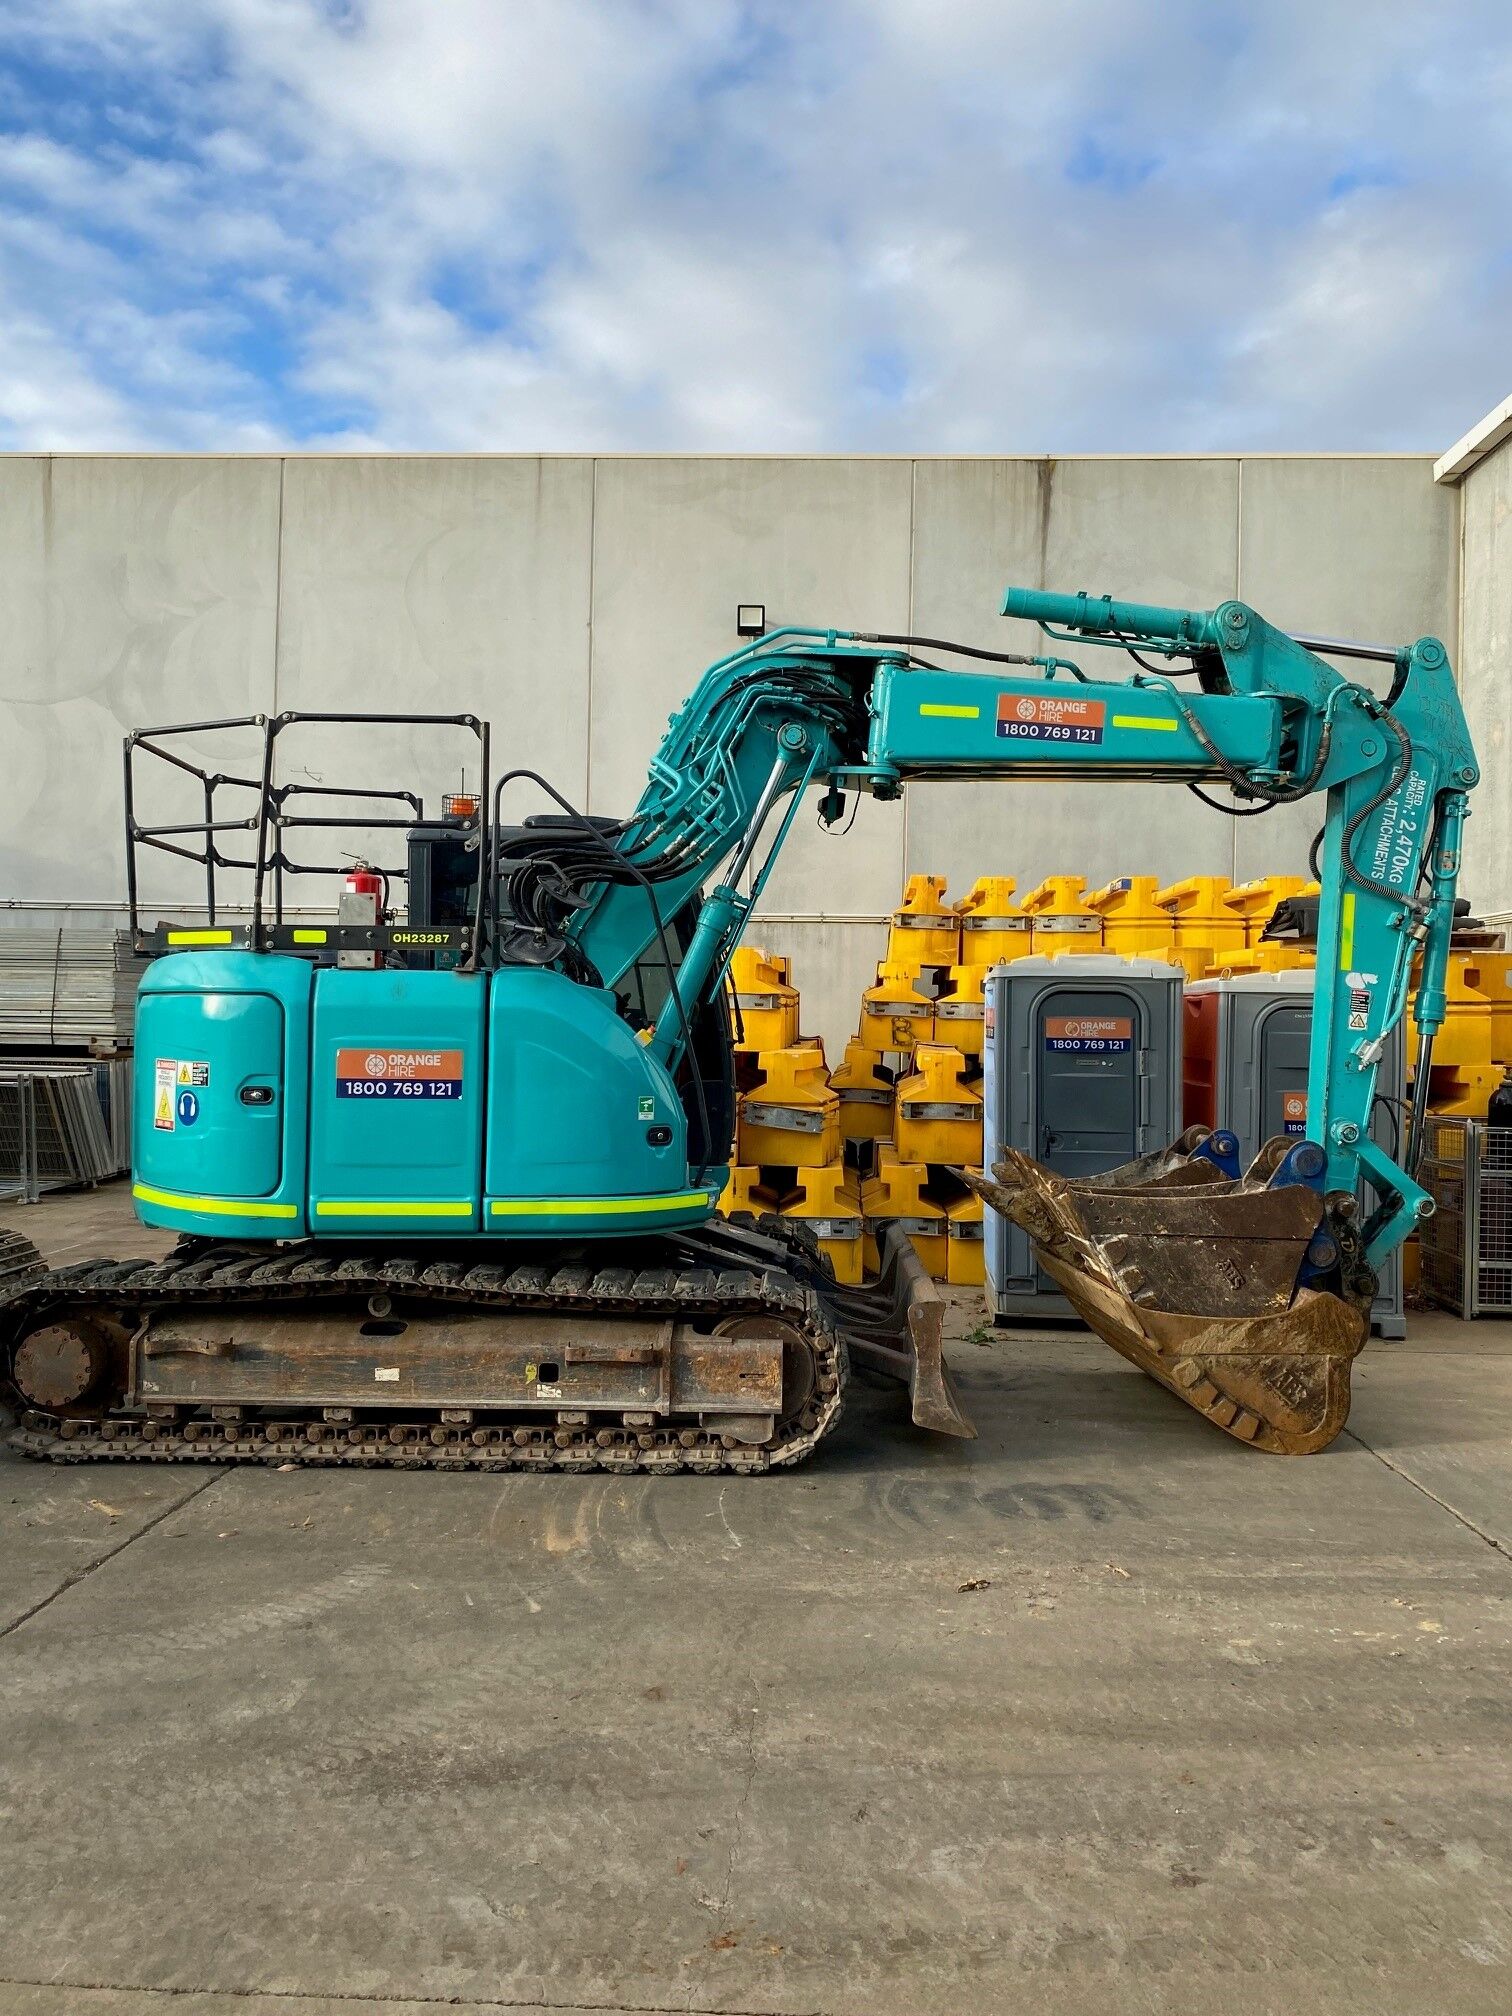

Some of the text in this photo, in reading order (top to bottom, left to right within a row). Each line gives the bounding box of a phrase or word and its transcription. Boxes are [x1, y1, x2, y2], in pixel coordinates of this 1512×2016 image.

[1039, 700, 1087, 713] ORANGE
[1038, 711, 1063, 722] HIRE
[1003, 723, 1096, 741] 1800 769 121
[1406, 770, 1419, 810] CAPACITY
[1414, 779, 1426, 806] RATED
[1371, 798, 1399, 879] ATTACHMENTS
[1388, 818, 1417, 884] 2,470KG
[392, 933, 450, 944] OH23287
[1080, 1022, 1116, 1030] ORANGE
[1080, 1029, 1099, 1037] HIRE
[1053, 1040, 1124, 1050] 1800 769 121
[388, 1054, 442, 1066] ORANGE
[388, 1065, 416, 1077] HIRE
[346, 1081, 452, 1096] 1800 769 121
